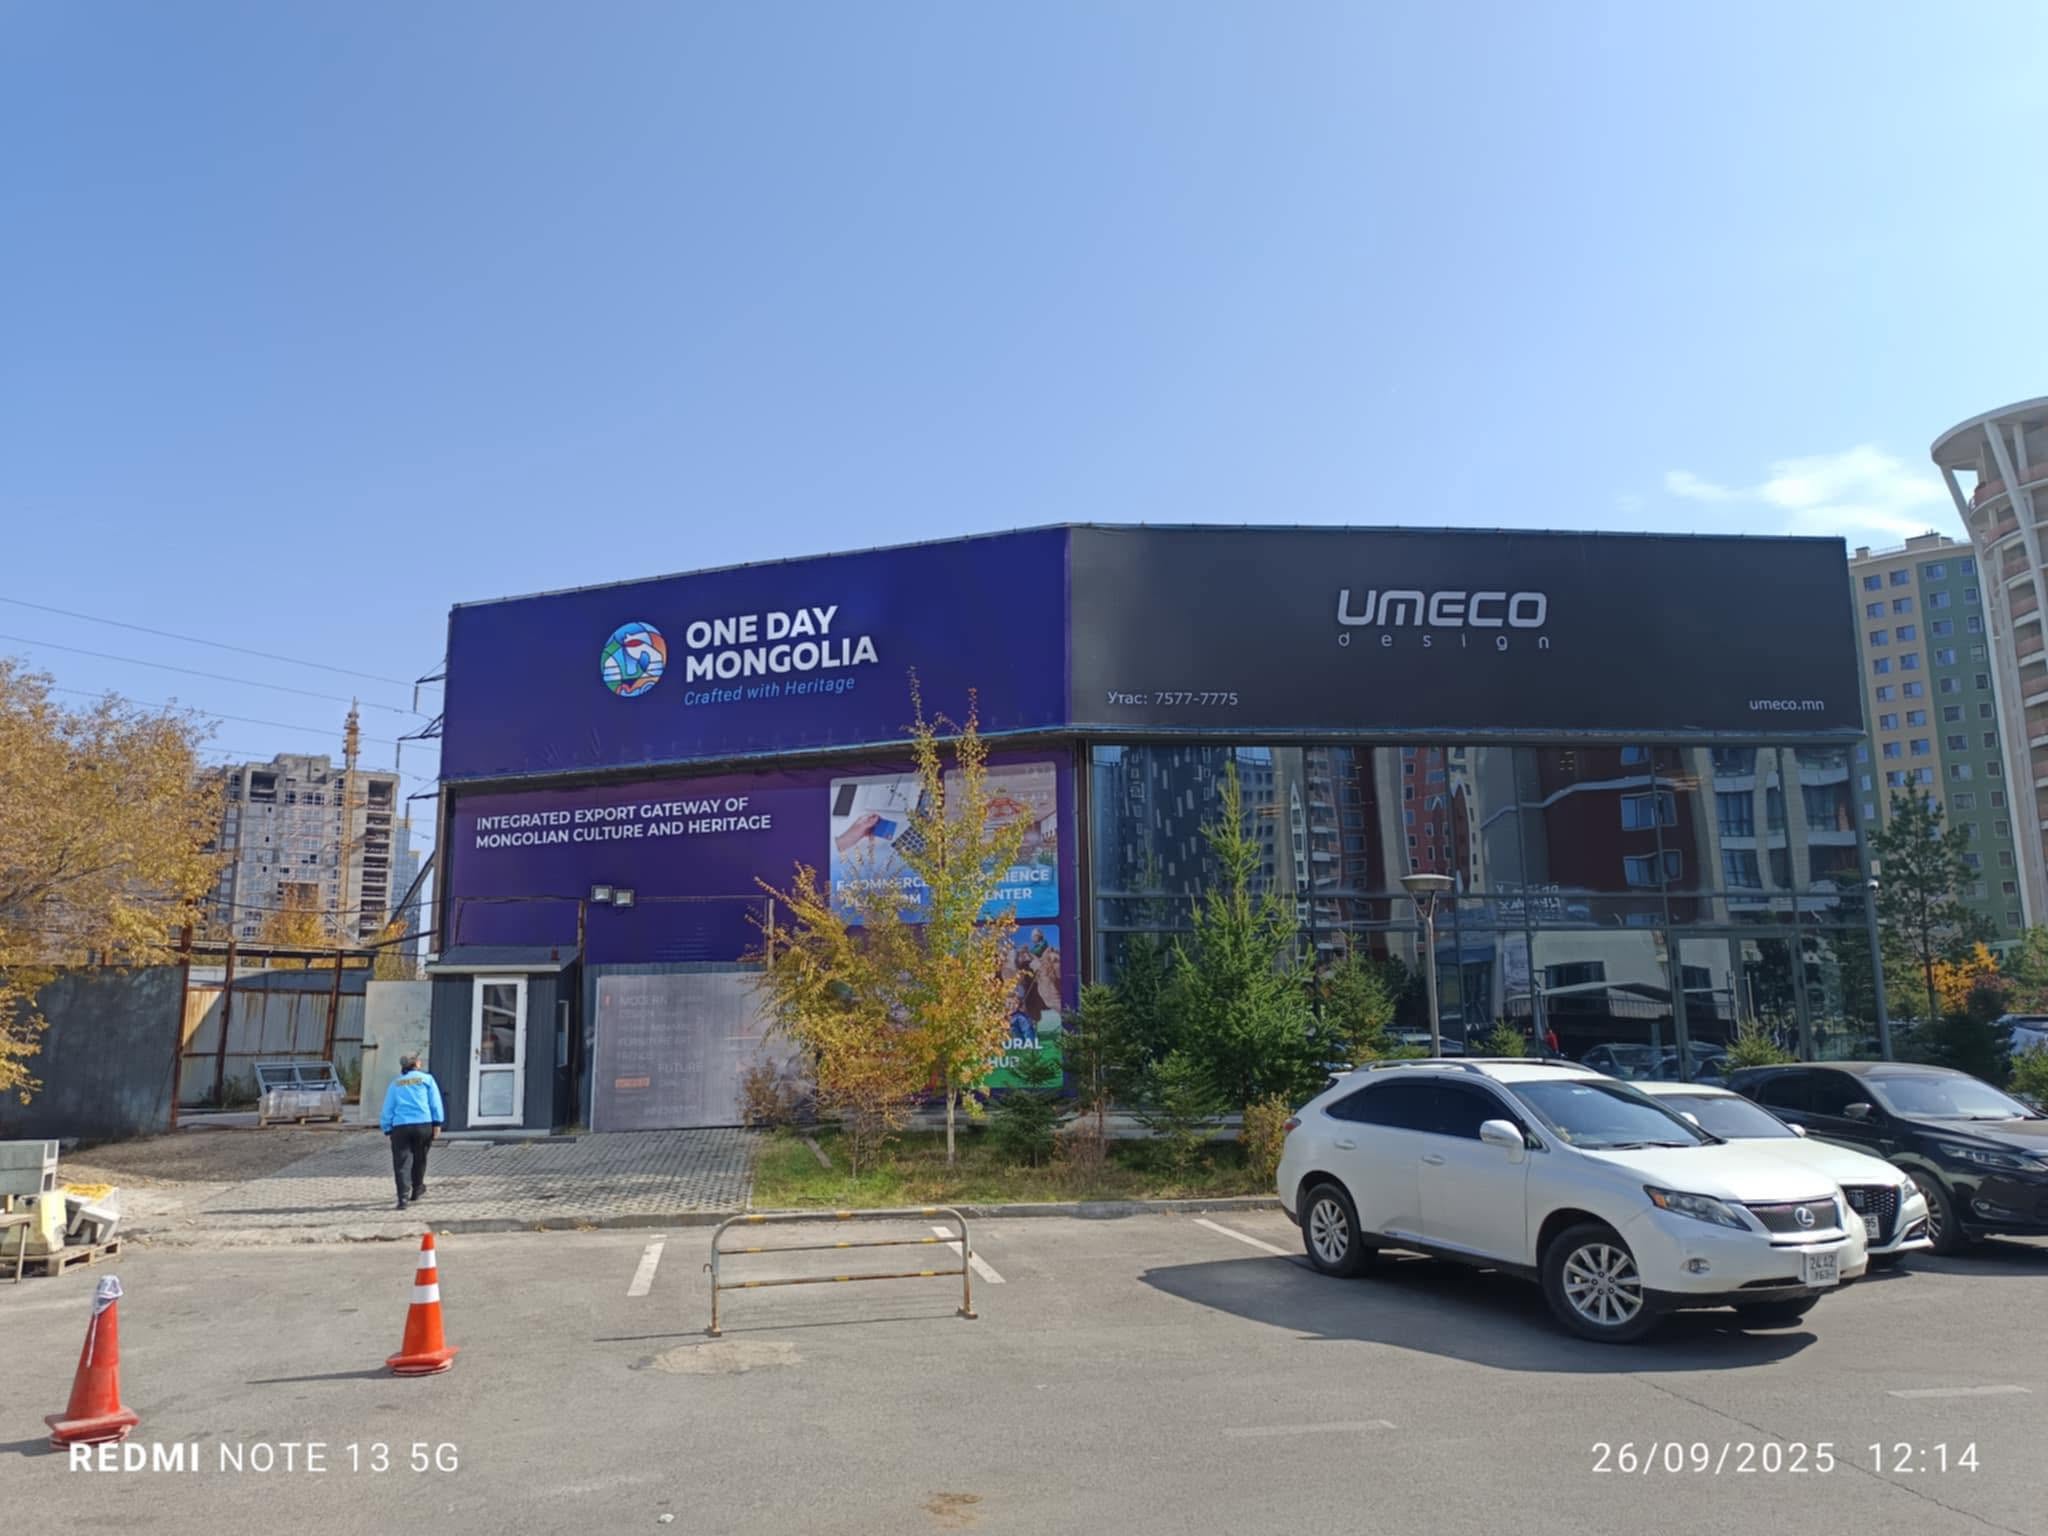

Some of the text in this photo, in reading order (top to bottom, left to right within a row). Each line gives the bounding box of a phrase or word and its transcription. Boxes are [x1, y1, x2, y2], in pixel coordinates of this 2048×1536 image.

[1337, 589, 1547, 628] UMECO
[686, 605, 838, 649] ONE DAY
[1338, 631, 1549, 651] design
[686, 635, 879, 683] MONGOLIA
[684, 677, 855, 706] Crafted with Heritage
[1107, 691, 1239, 705] Утас: 7577-7775
[1749, 699, 1825, 711] umeco.mn
[476, 797, 749, 831] INTEGRATED EXPORT GATEWAY OF
[475, 815, 772, 848] MONGOLIAN CULTURE AND HERITAGE
[984, 888, 1033, 902] ENTER
